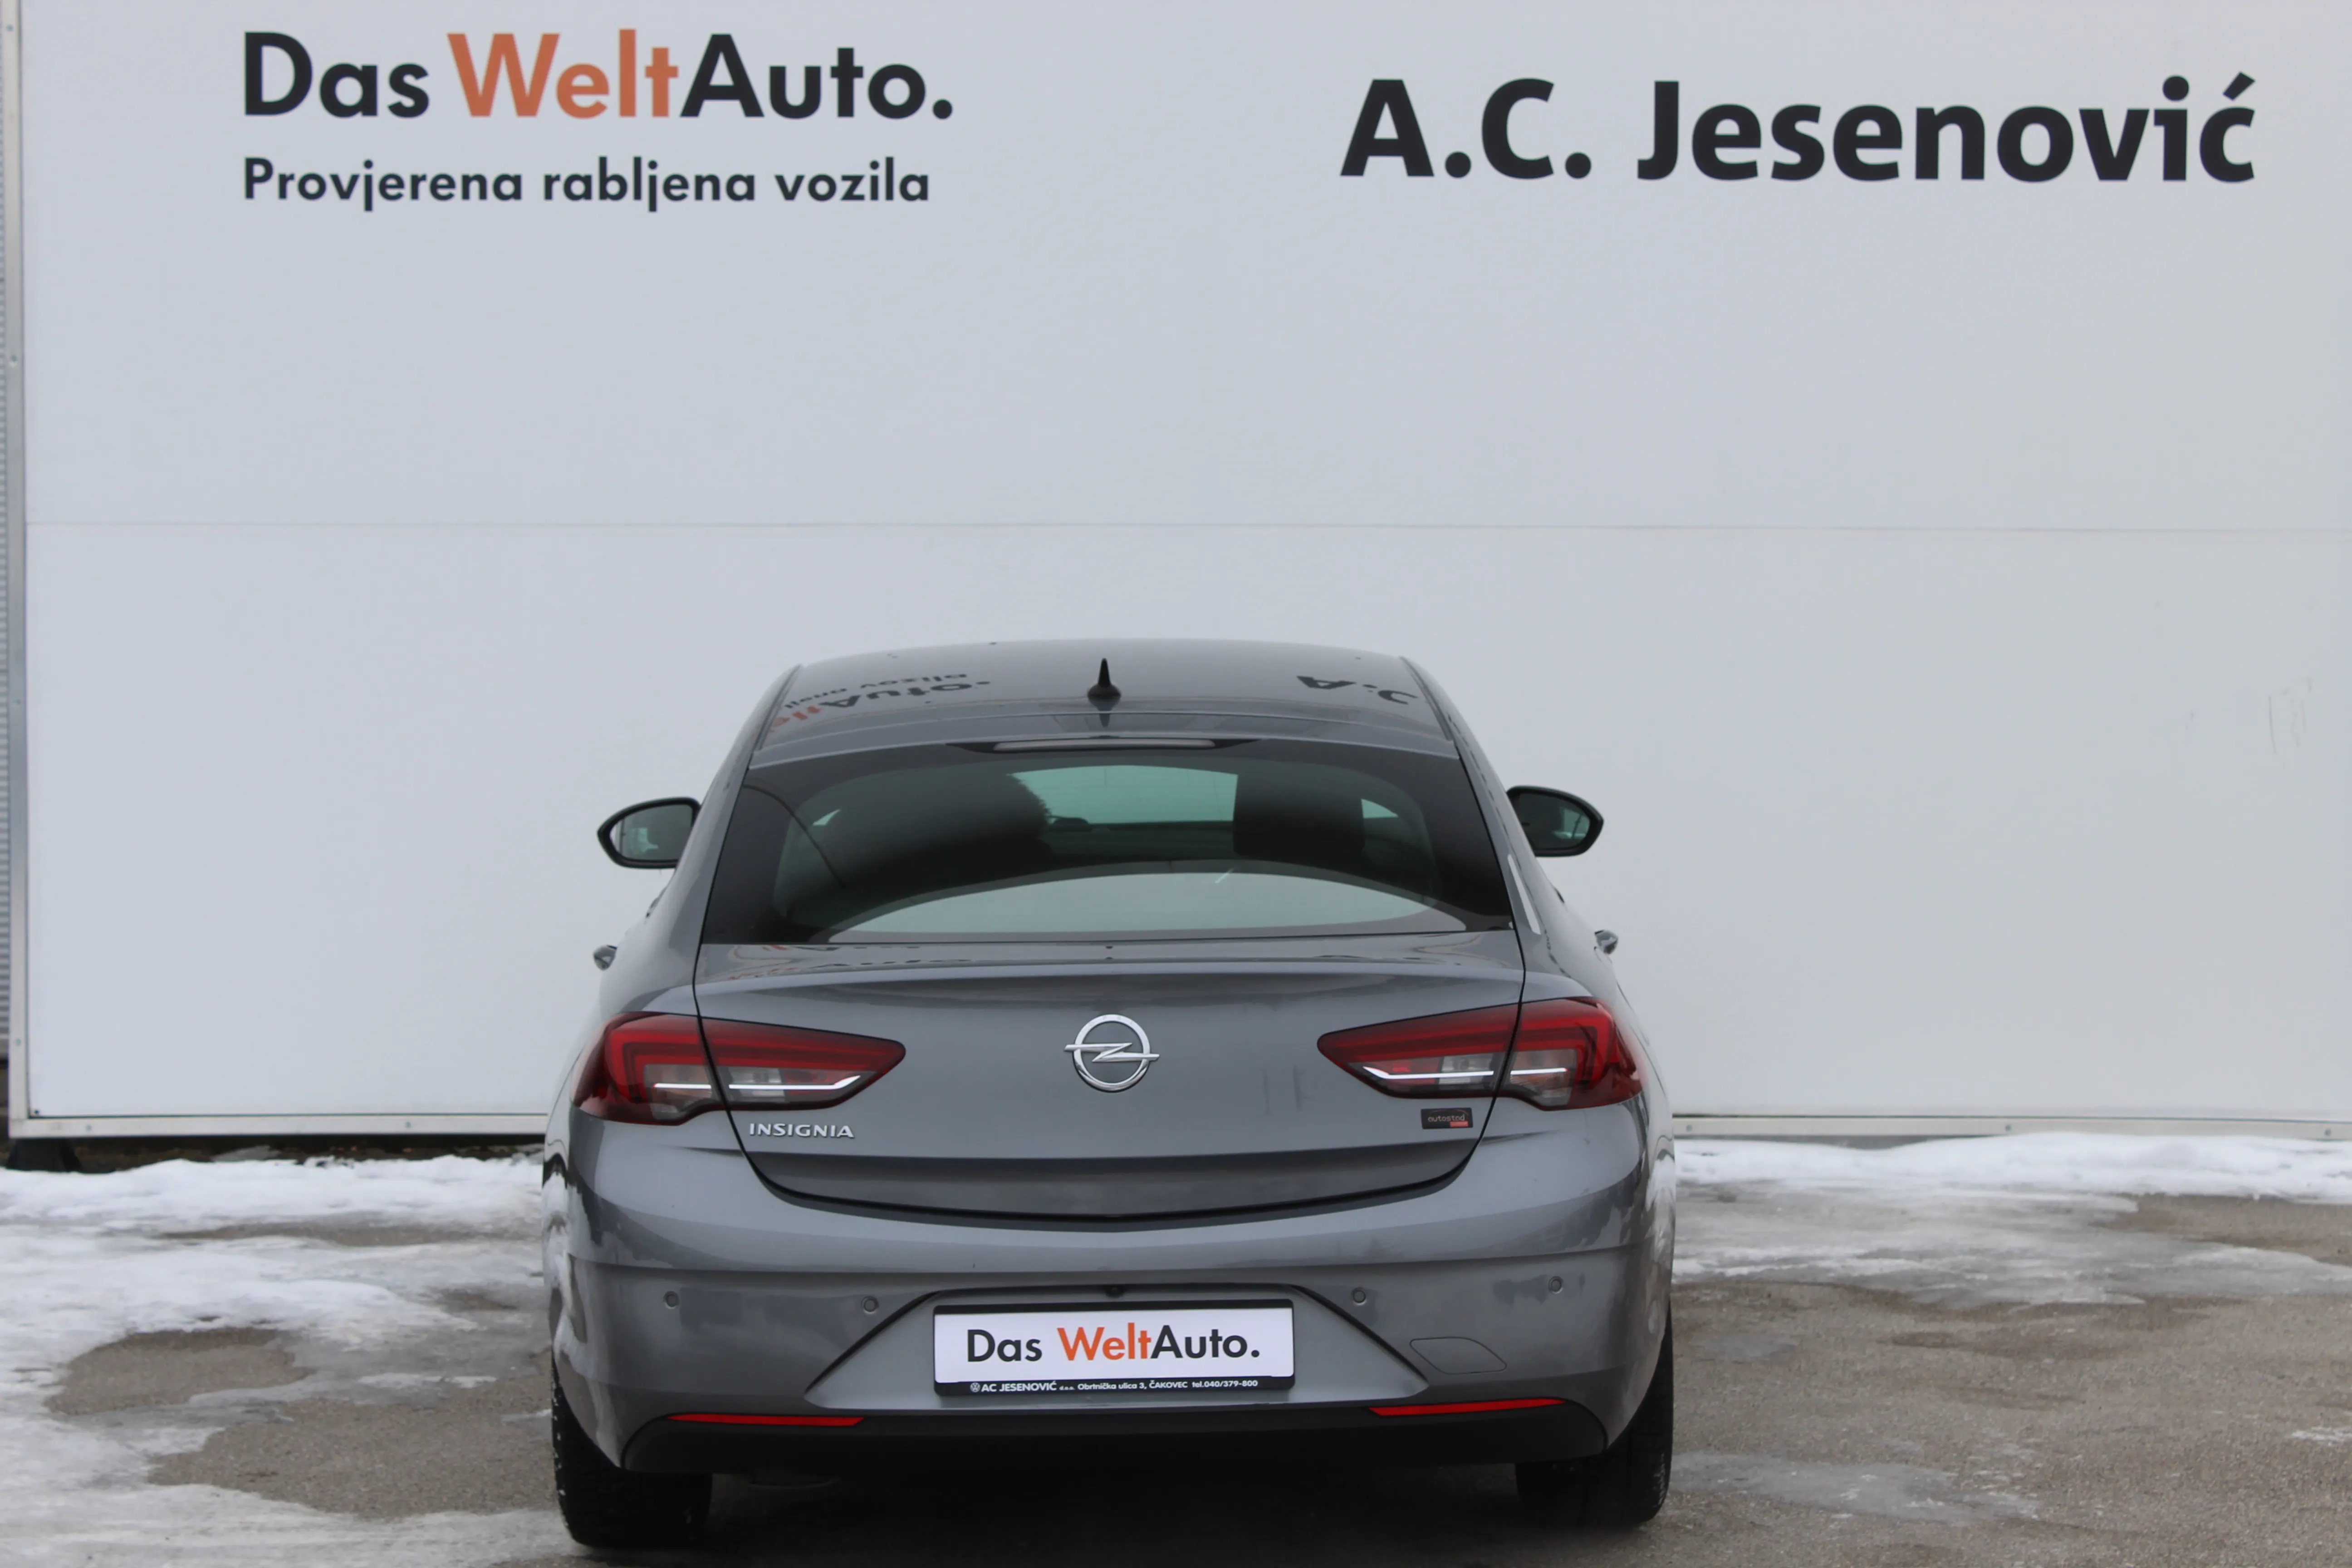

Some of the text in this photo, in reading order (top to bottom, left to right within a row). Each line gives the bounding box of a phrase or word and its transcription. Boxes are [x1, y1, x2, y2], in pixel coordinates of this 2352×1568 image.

[245, 29, 953, 120] Das WeltAuto.
[1340, 72, 2255, 183] A.C. Jesenović
[245, 156, 928, 212] Provjerena rabljena vozila
[749, 1123, 854, 1138] INSIGNIA
[967, 1322, 1260, 1362] Das WeltAuto.
[981, 1383, 997, 1392] AC
[999, 1380, 1057, 1392] JESENOVIĆ
[1077, 1382, 1117, 1391] Obrtnička
[1149, 1380, 1188, 1389] ČAKOVEC
[1192, 1380, 1258, 1388] tel.040/379-800
